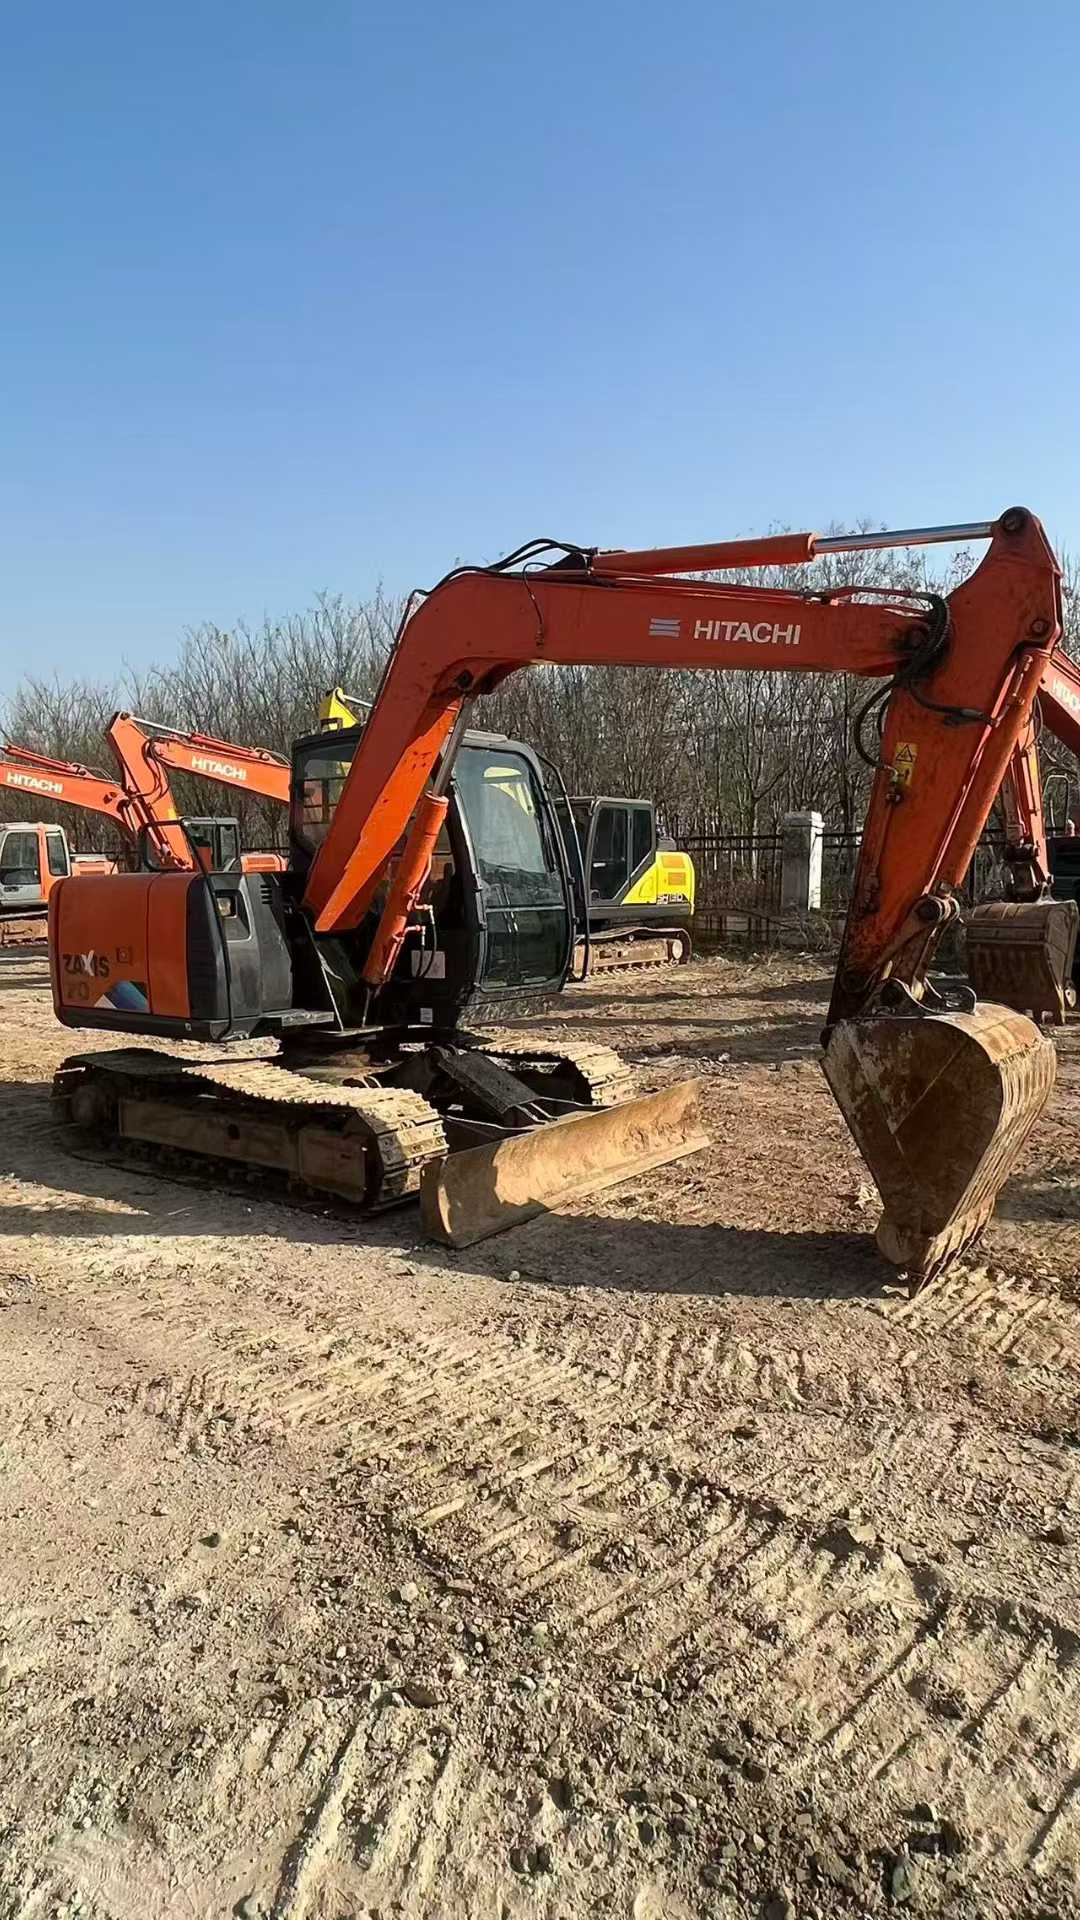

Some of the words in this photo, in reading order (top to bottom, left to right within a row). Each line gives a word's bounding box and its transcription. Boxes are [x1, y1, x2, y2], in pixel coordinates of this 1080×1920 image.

[694, 619, 801, 645] HITACHI
[191, 755, 247, 781] HITACHI
[7, 771, 64, 794] HITACHI
[62, 950, 110, 978] ZAXIS
